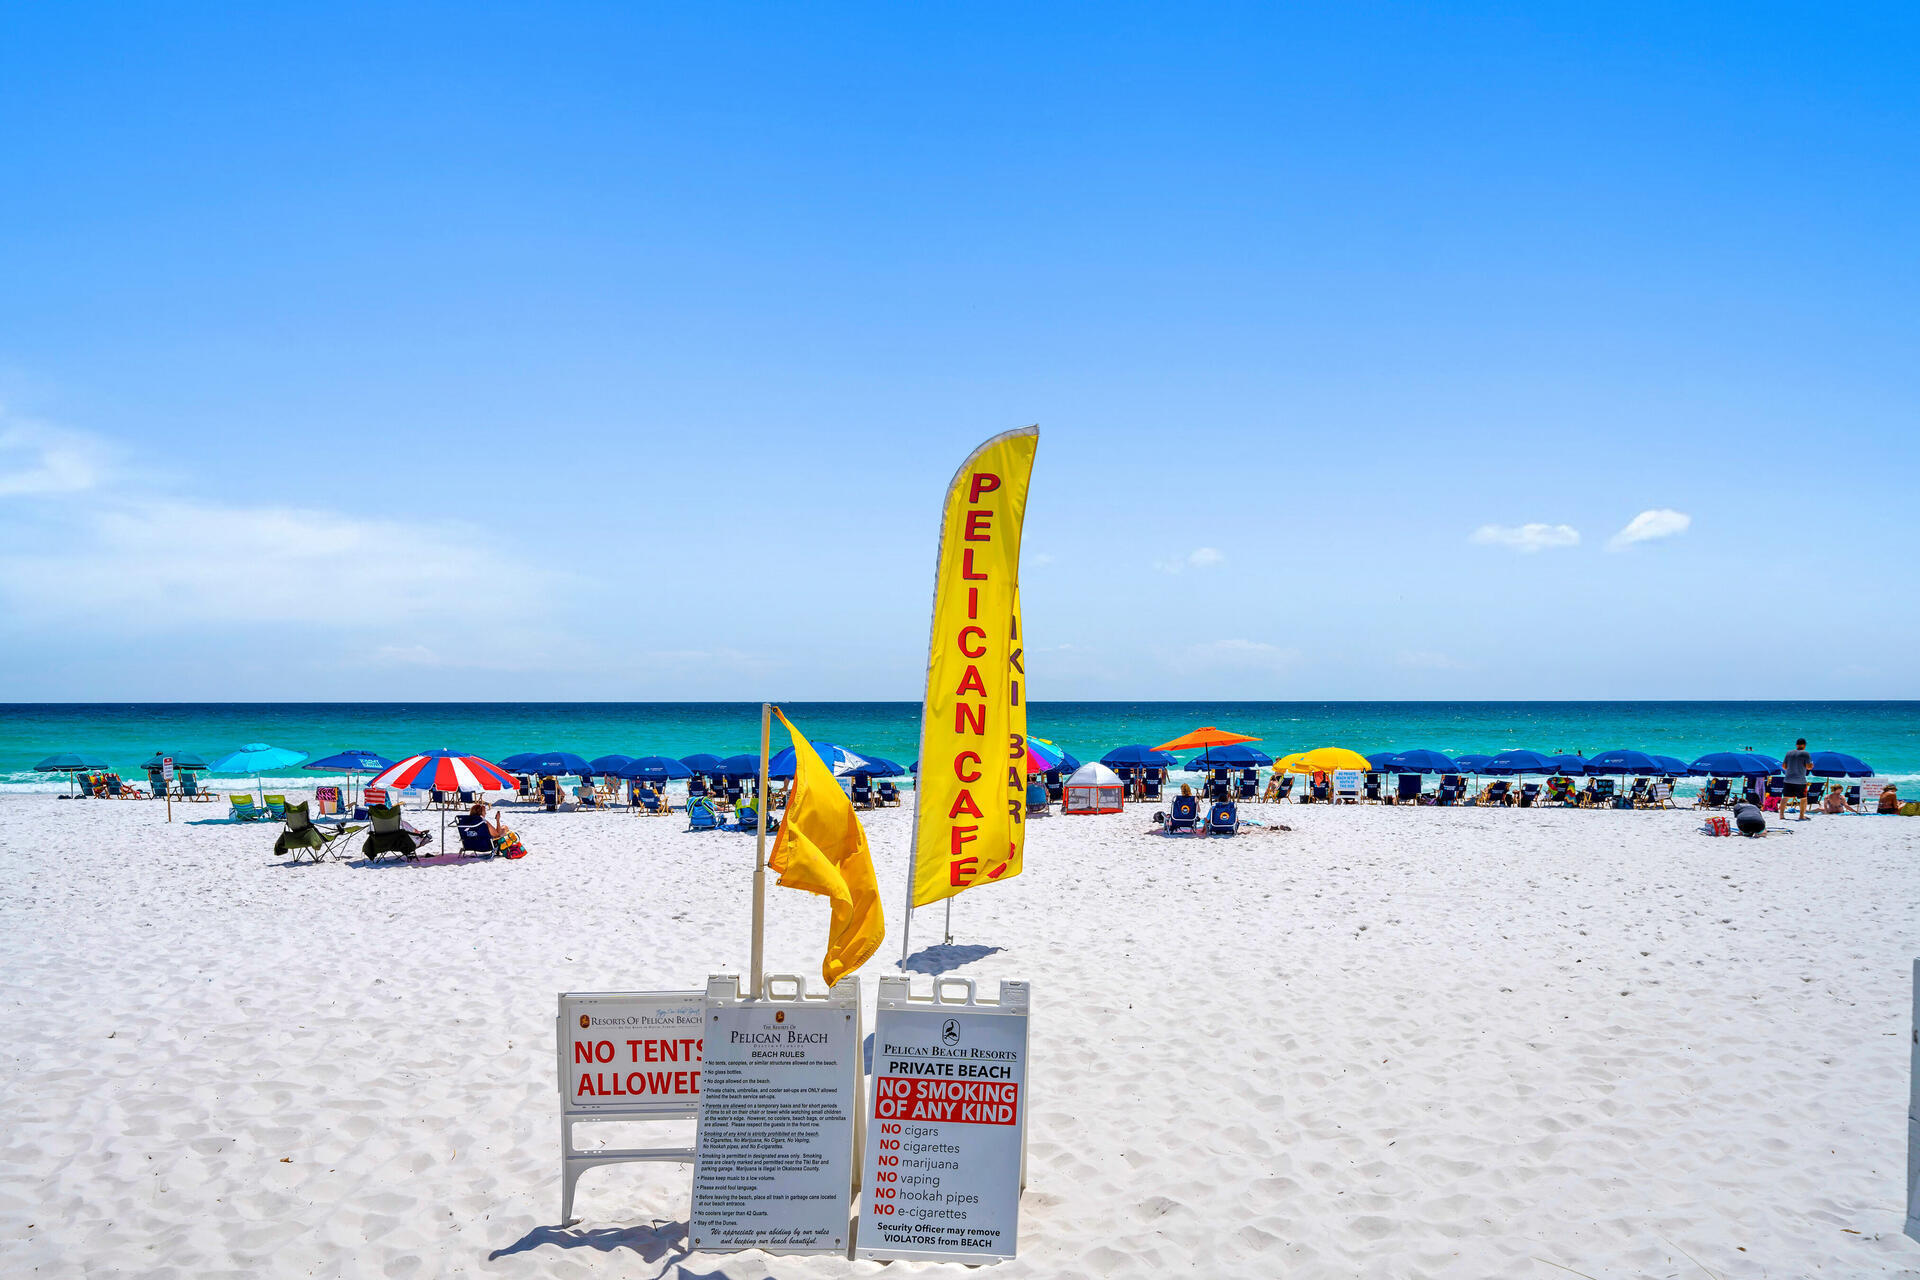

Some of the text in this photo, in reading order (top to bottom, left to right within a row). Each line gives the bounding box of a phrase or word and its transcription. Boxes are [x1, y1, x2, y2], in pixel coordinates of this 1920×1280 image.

[948, 472, 1002, 887] PELICAN CAFE
[1008, 614, 1025, 824] IKI BAR
[641, 1015, 674, 1025] PELICAN
[676, 1014, 702, 1024] BEACH
[731, 1031, 827, 1043] PELICAN BEACH
[575, 1040, 615, 1064] NO
[884, 1044, 1017, 1060] PELICAN BEACH RESORTS
[890, 1062, 1011, 1078] PRIVATE BEACH
[879, 1080, 1016, 1103] NO SMOKING
[878, 1099, 1013, 1122] OF ANY KIND
[881, 1124, 938, 1138] NO cigars
[880, 1140, 960, 1154] NO cigarettes
[878, 1156, 959, 1171] NO marijuana
[877, 1172, 940, 1188] NO vaping
[876, 1188, 978, 1205] NO hookah pipes
[874, 1204, 967, 1220] NO e-cigarettes
[877, 1222, 912, 1232] Security
[915, 1224, 945, 1234] Officer
[946, 1228, 966, 1236] may
[884, 1234, 992, 1247] VIOLATORS from BEACH
